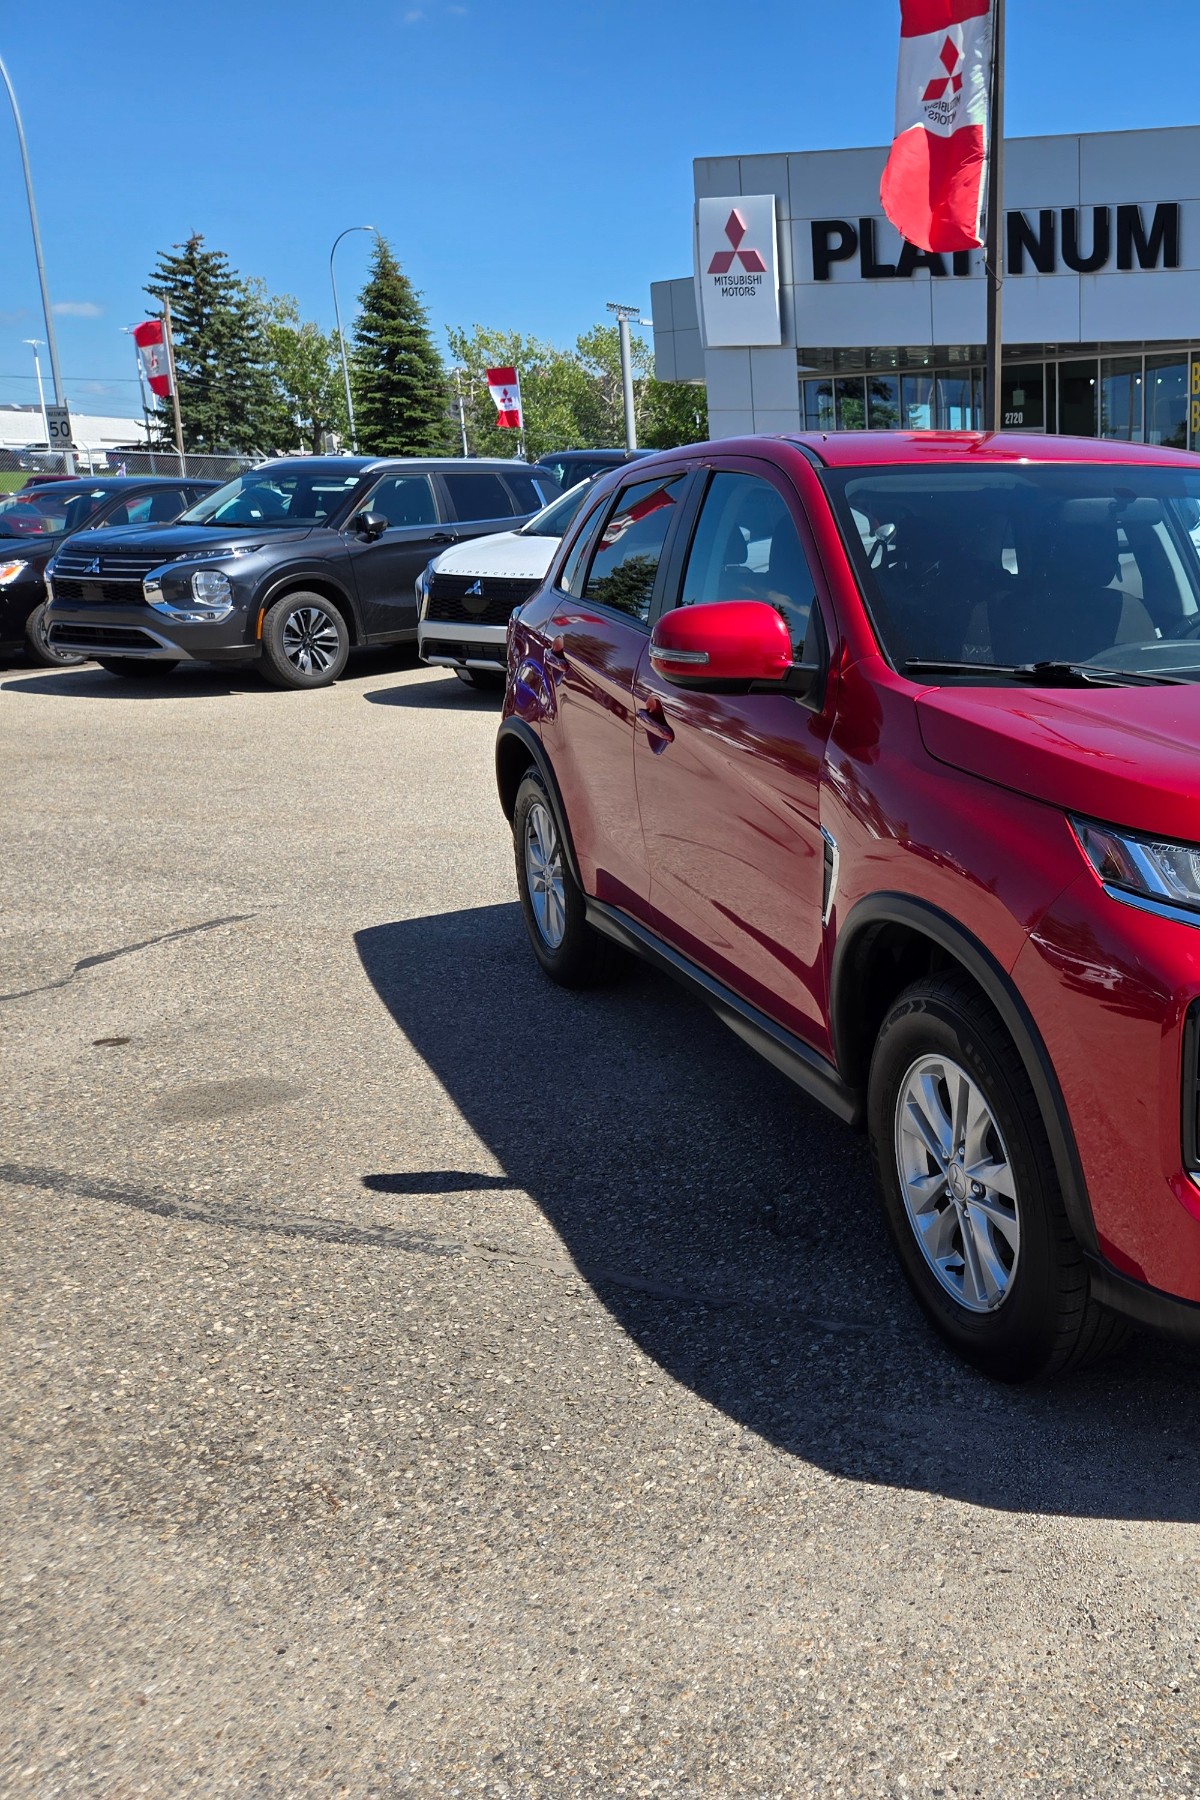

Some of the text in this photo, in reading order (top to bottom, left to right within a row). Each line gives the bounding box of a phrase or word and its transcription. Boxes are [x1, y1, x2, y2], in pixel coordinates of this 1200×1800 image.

[811, 203, 1179, 281] PLANUM
[714, 275, 762, 286] MITSUBISHI
[721, 286, 756, 297] MOTORS
[1005, 411, 1023, 424] 2720
[49, 421, 70, 437] 50
